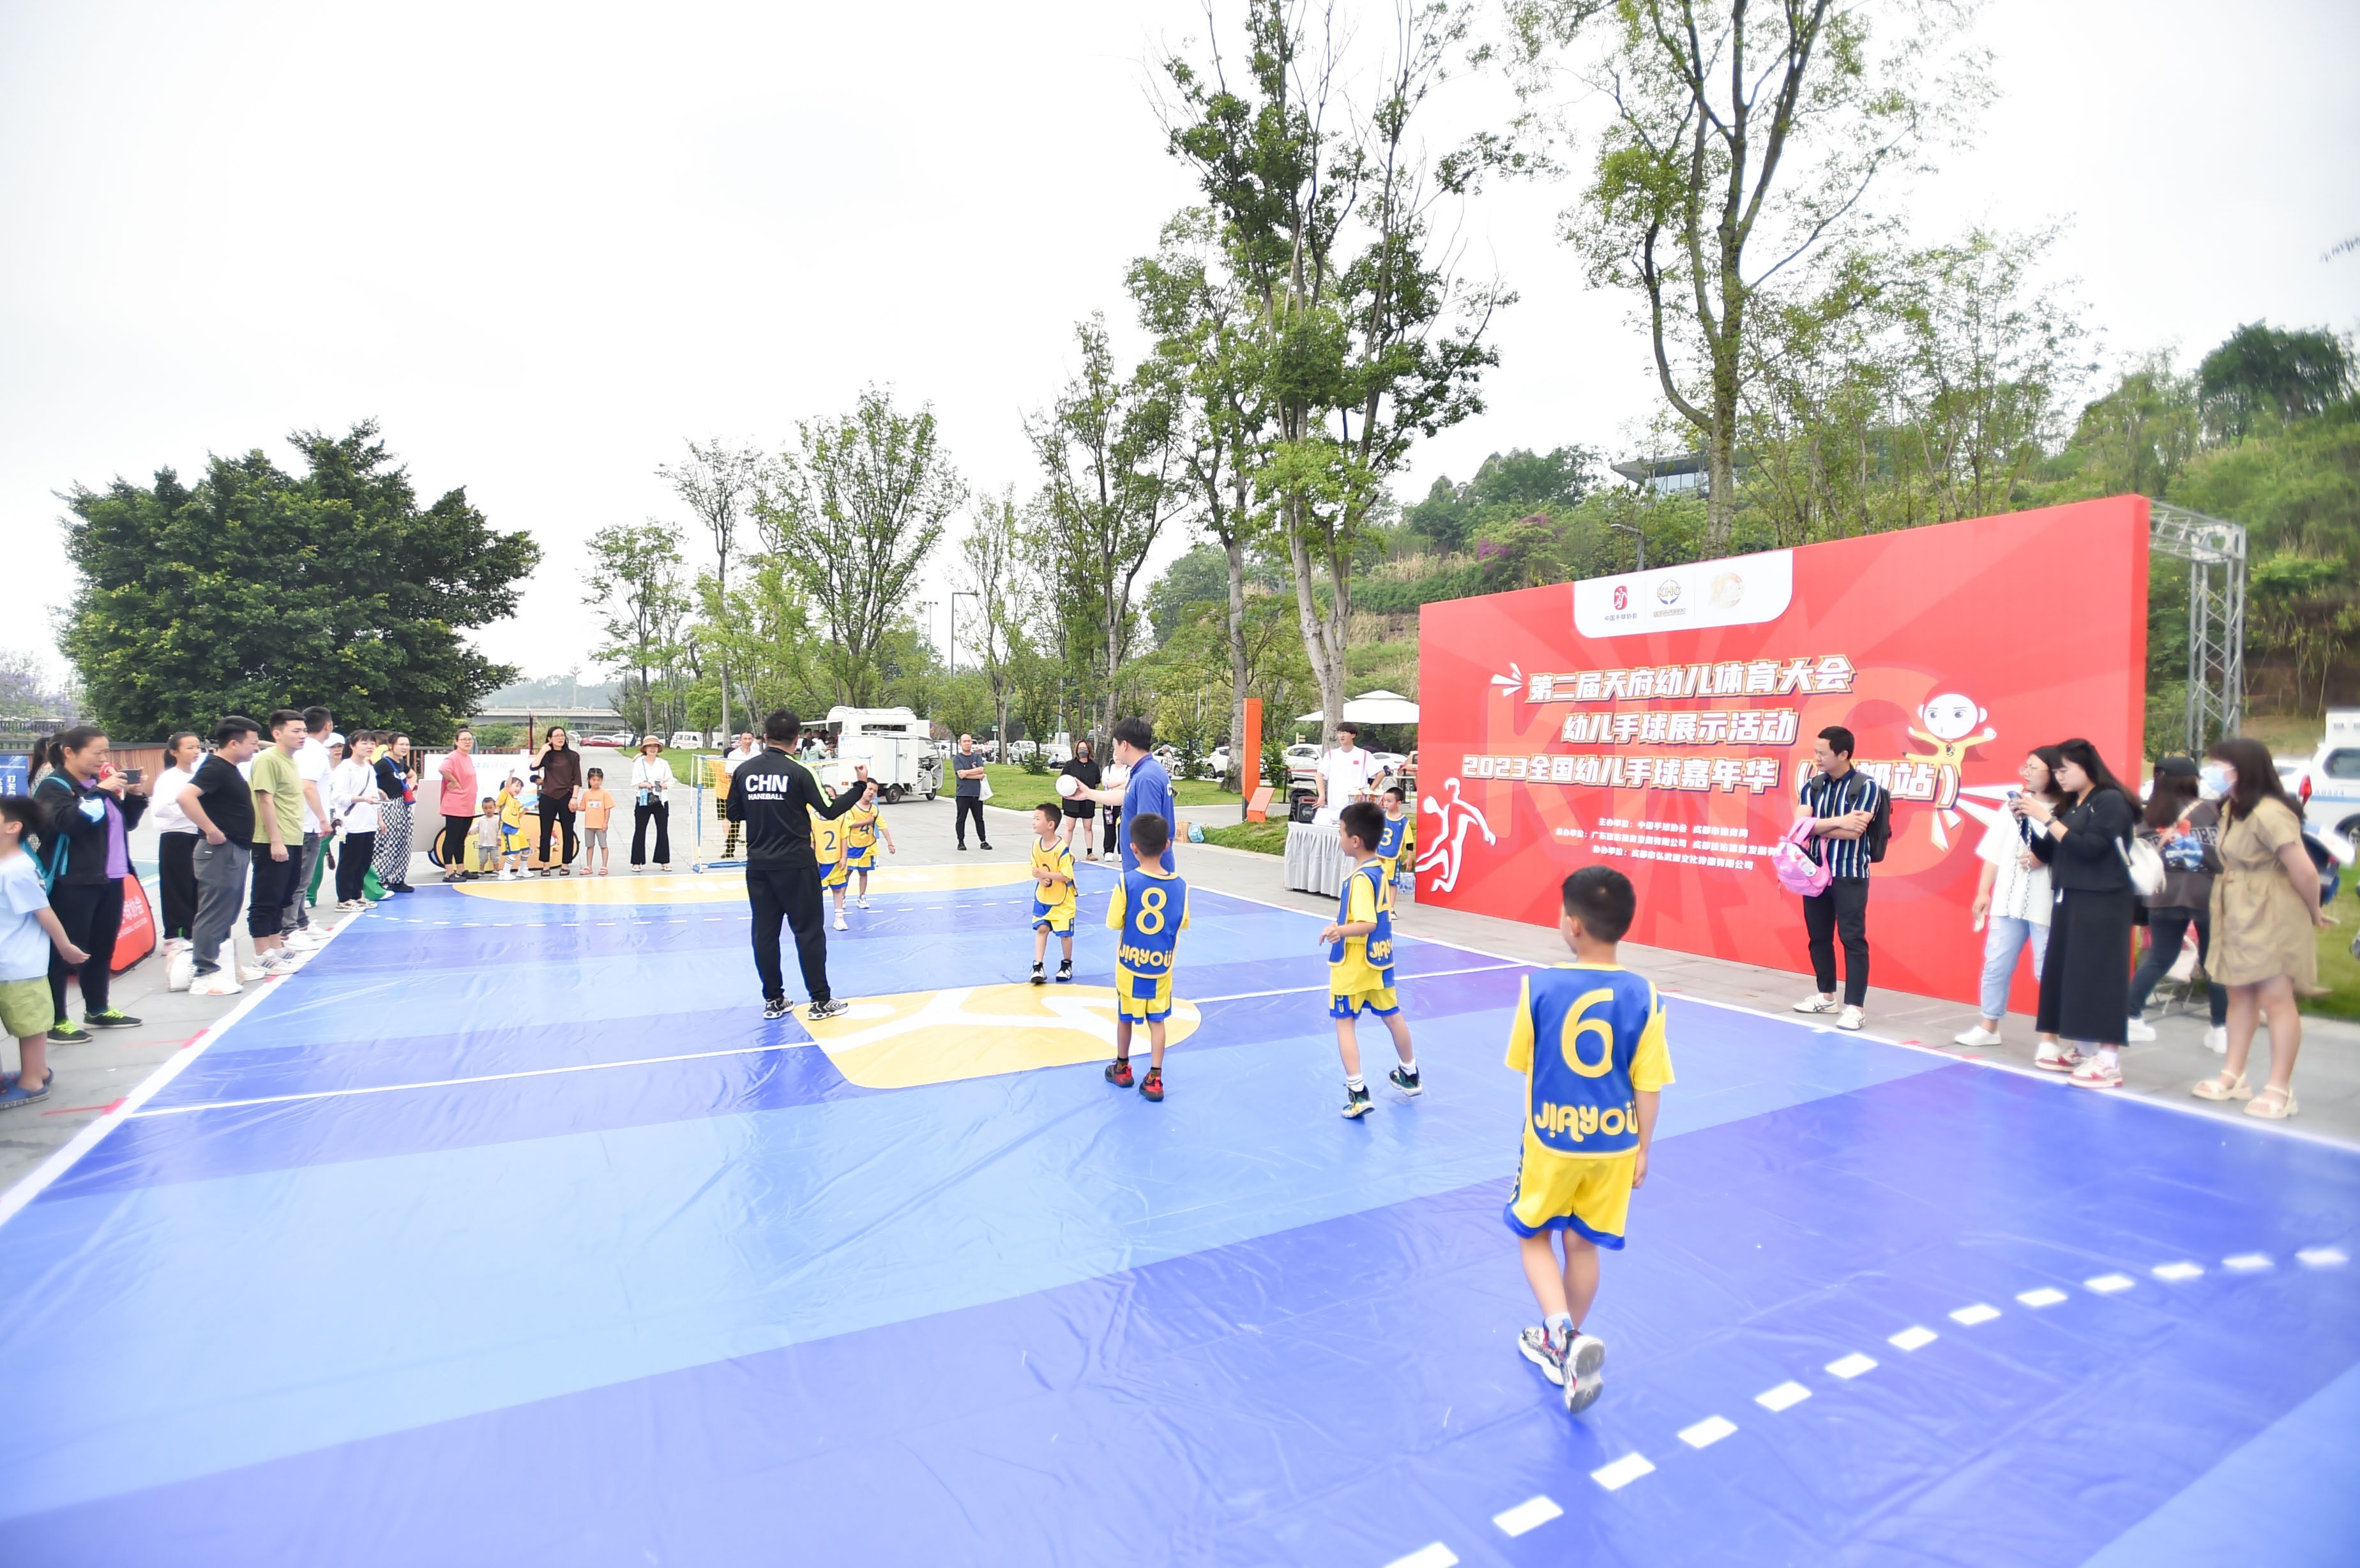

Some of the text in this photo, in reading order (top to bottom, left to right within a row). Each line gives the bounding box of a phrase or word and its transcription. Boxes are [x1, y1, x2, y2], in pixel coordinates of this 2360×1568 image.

[1656, 585, 1681, 598] KHC
[1526, 654, 1856, 702] 第二届天府幼儿体育大会
[1562, 708, 1797, 744] 幼儿手球展示活动
[745, 774, 789, 792] CHN
[824, 830, 837, 851] 2
[1380, 827, 1393, 847] 3
[1136, 887, 1167, 935] 8
[1561, 988, 1614, 1078] 6
